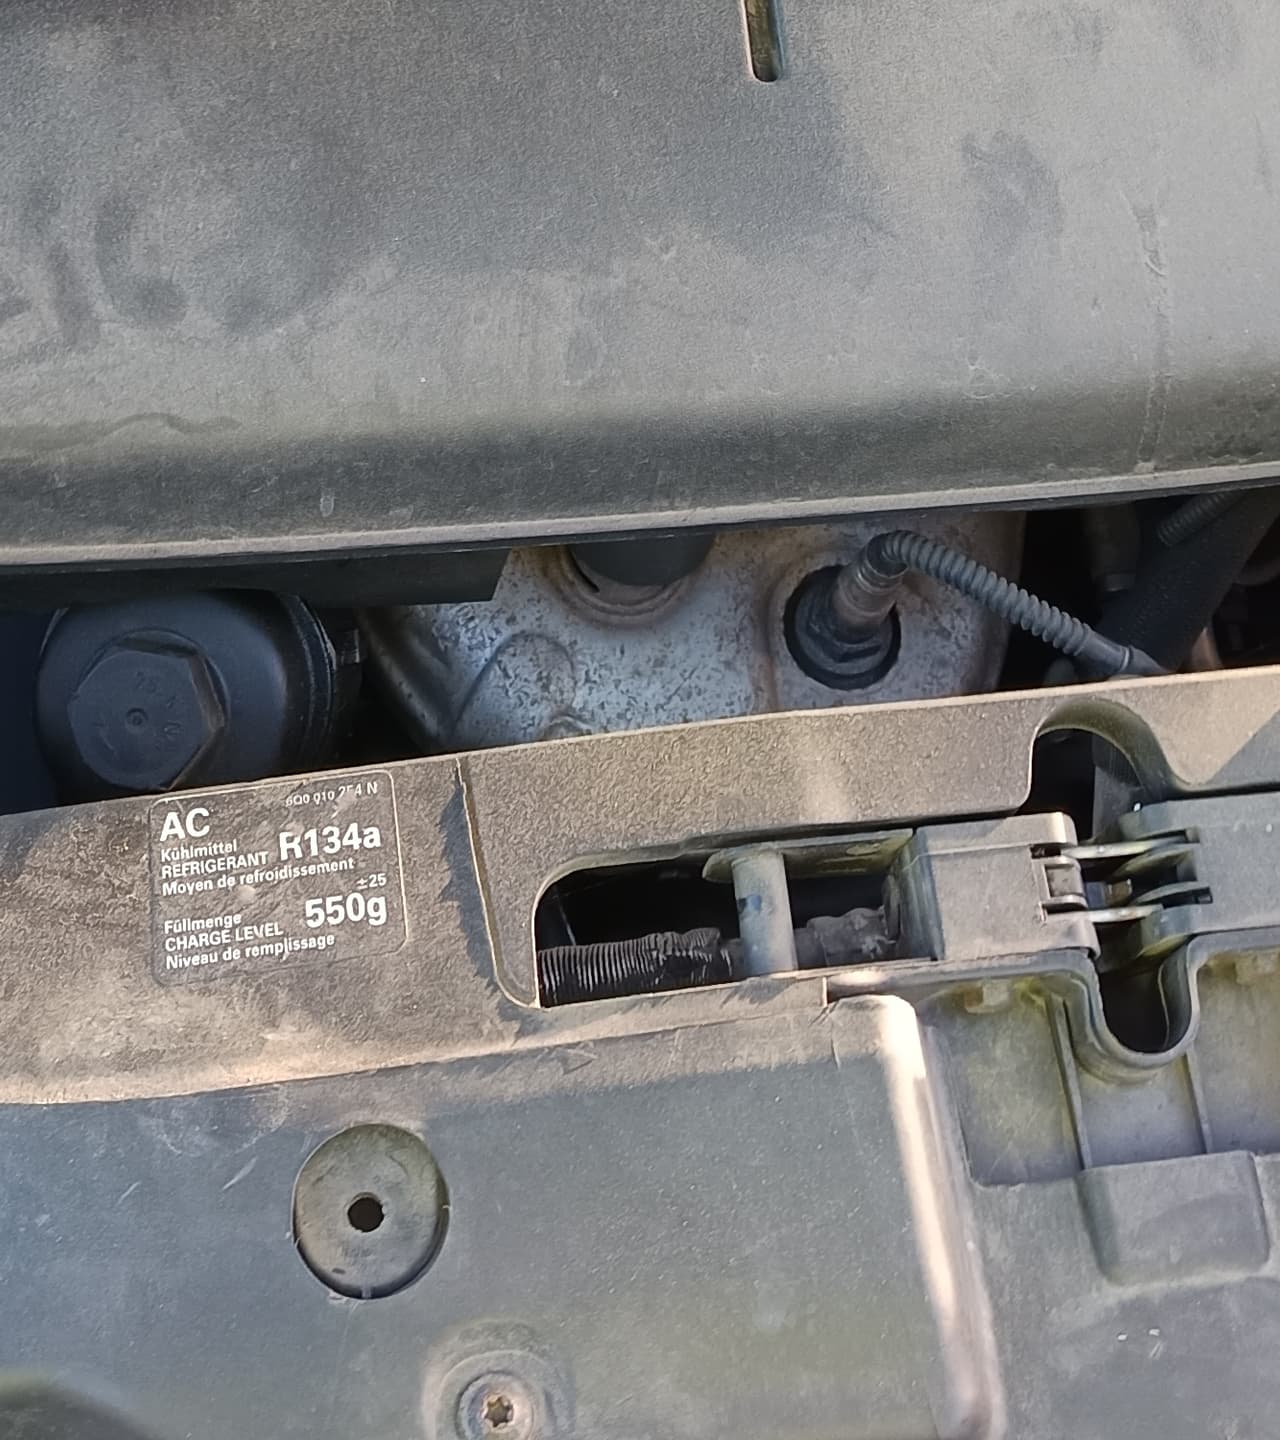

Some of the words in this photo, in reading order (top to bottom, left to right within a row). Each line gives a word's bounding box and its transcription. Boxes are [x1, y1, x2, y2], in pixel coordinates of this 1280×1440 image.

[159, 807, 210, 842] AC
[161, 839, 237, 862] Kühlmittel
[161, 851, 270, 880] REFRIGERANT
[279, 822, 382, 861] R134a
[162, 876, 213, 896] Moyen
[217, 873, 236, 888] de
[239, 858, 355, 886] refroidissement
[164, 912, 242, 935] Füllmenge
[304, 892, 388, 928] 550g
[165, 928, 232, 952] CHARGE
[235, 921, 284, 942] LEVEL
[165, 949, 219, 970] Niveau
[222, 945, 241, 961] de
[245, 933, 336, 959] remplissage
